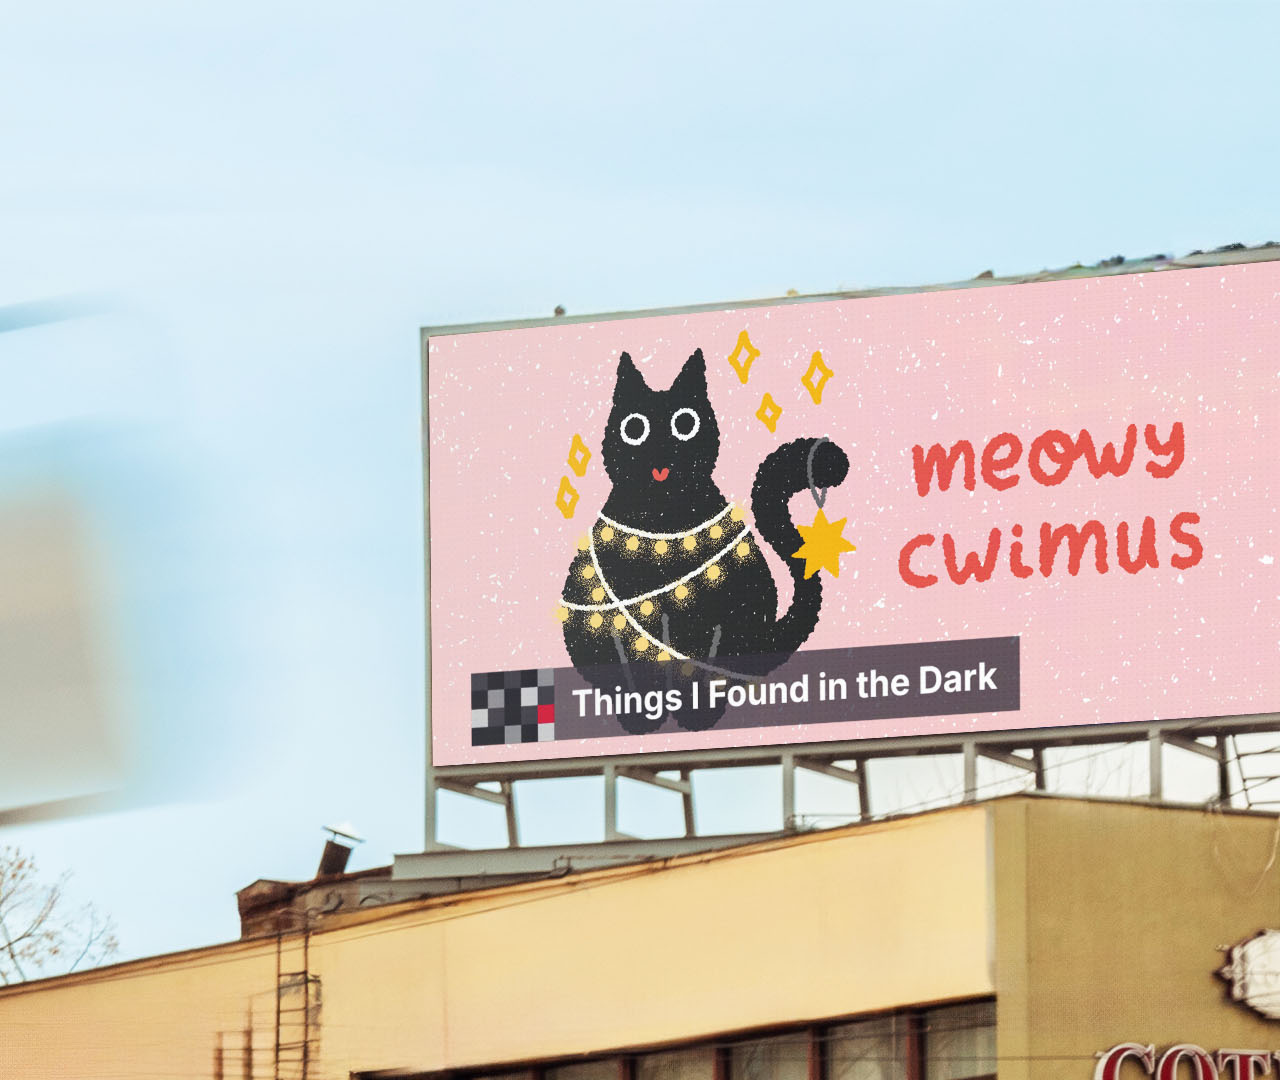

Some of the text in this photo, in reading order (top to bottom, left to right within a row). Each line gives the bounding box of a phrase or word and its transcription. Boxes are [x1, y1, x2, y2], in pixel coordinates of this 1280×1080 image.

[911, 421, 1186, 498] meowy
[898, 511, 1205, 590] cwimus
[571, 660, 999, 719] Things I Found in the Dark
